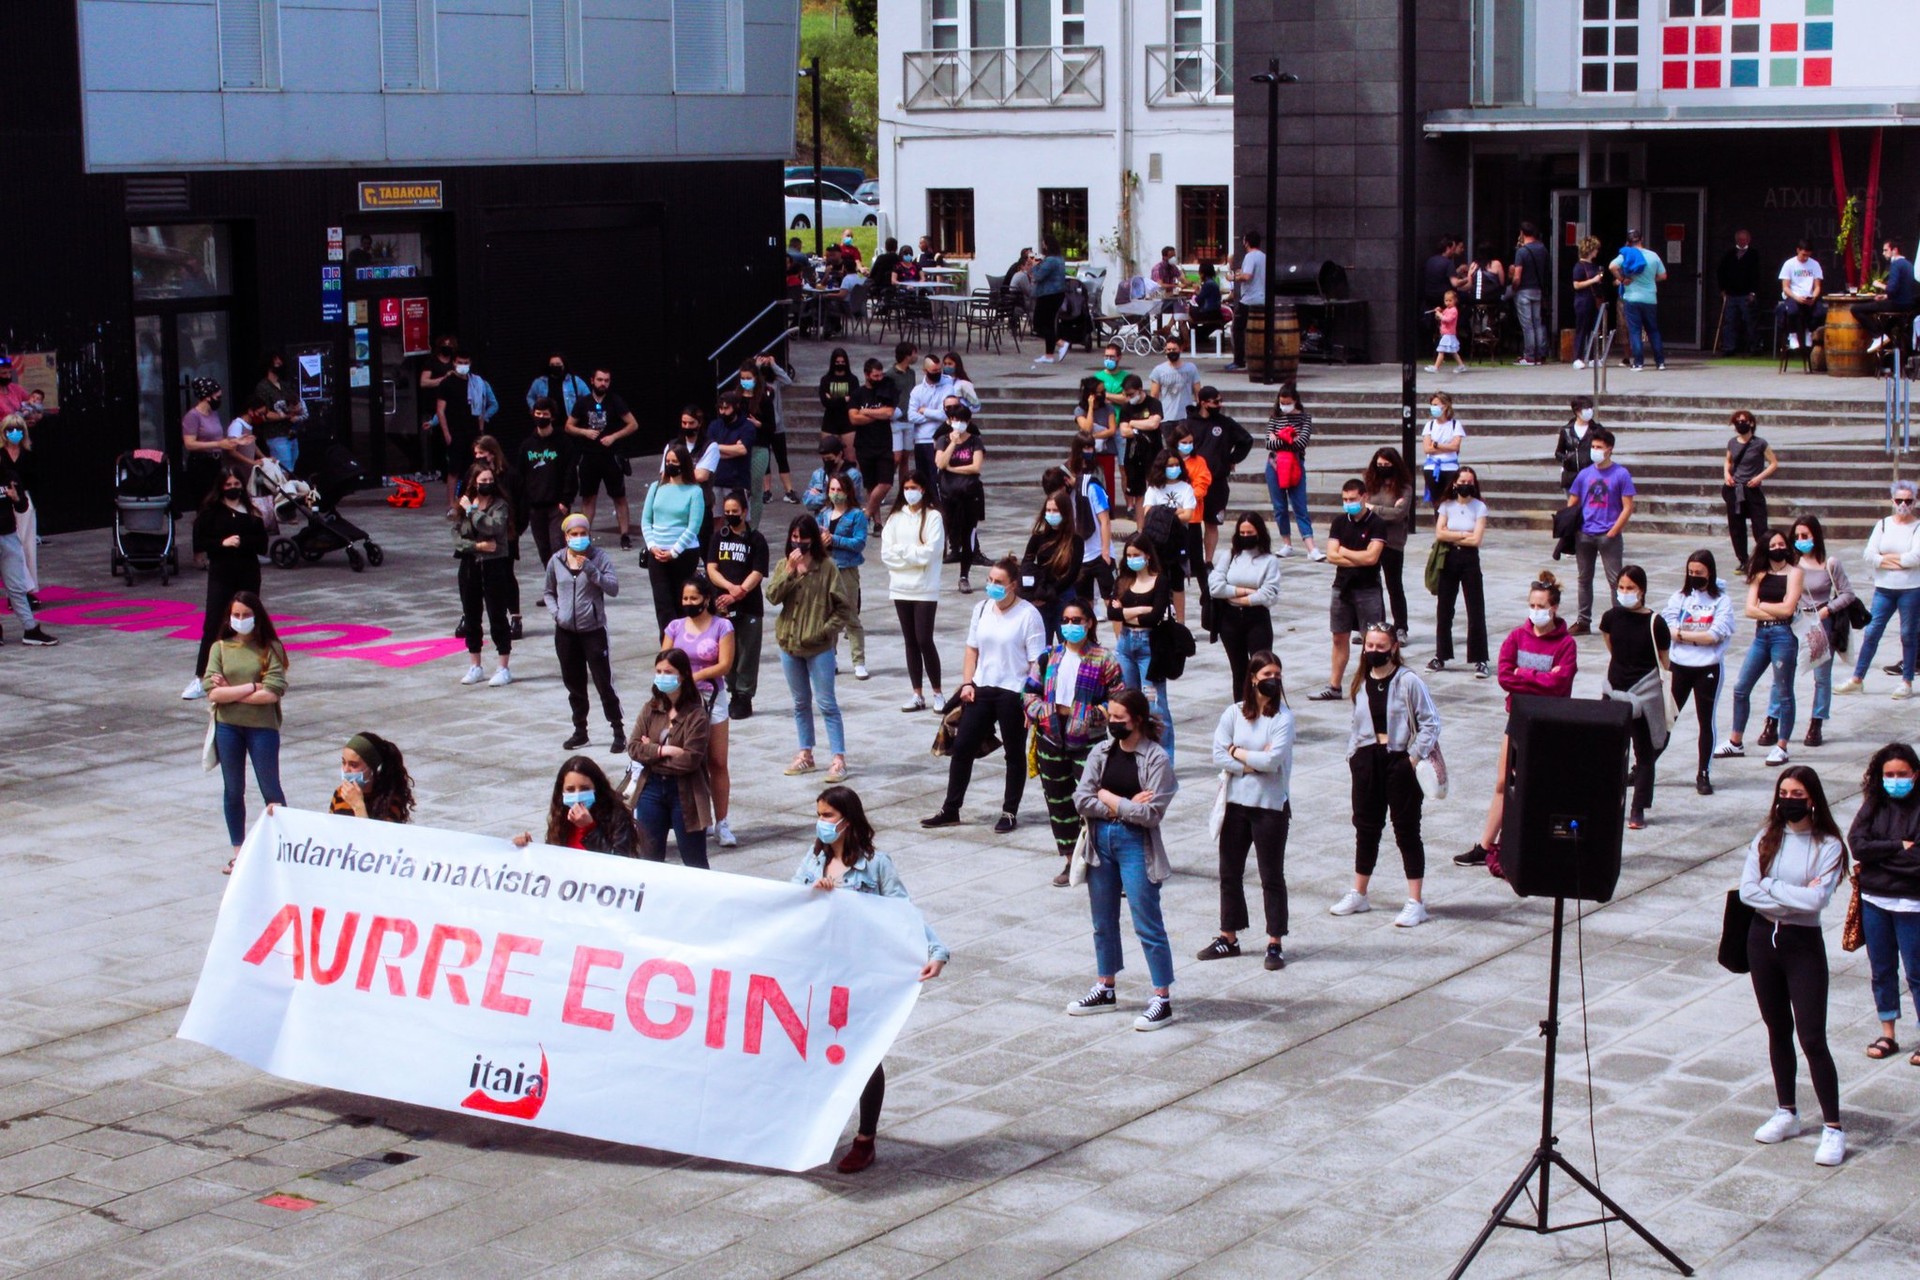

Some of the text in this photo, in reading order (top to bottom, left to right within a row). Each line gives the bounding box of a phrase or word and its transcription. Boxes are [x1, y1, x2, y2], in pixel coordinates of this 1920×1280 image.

[378, 186, 438, 199] TABAKOAK
[277, 834, 645, 912] indarkeria matxista orori
[242, 903, 850, 1065] AURRE EGIN!
[469, 1054, 543, 1097] itaia
